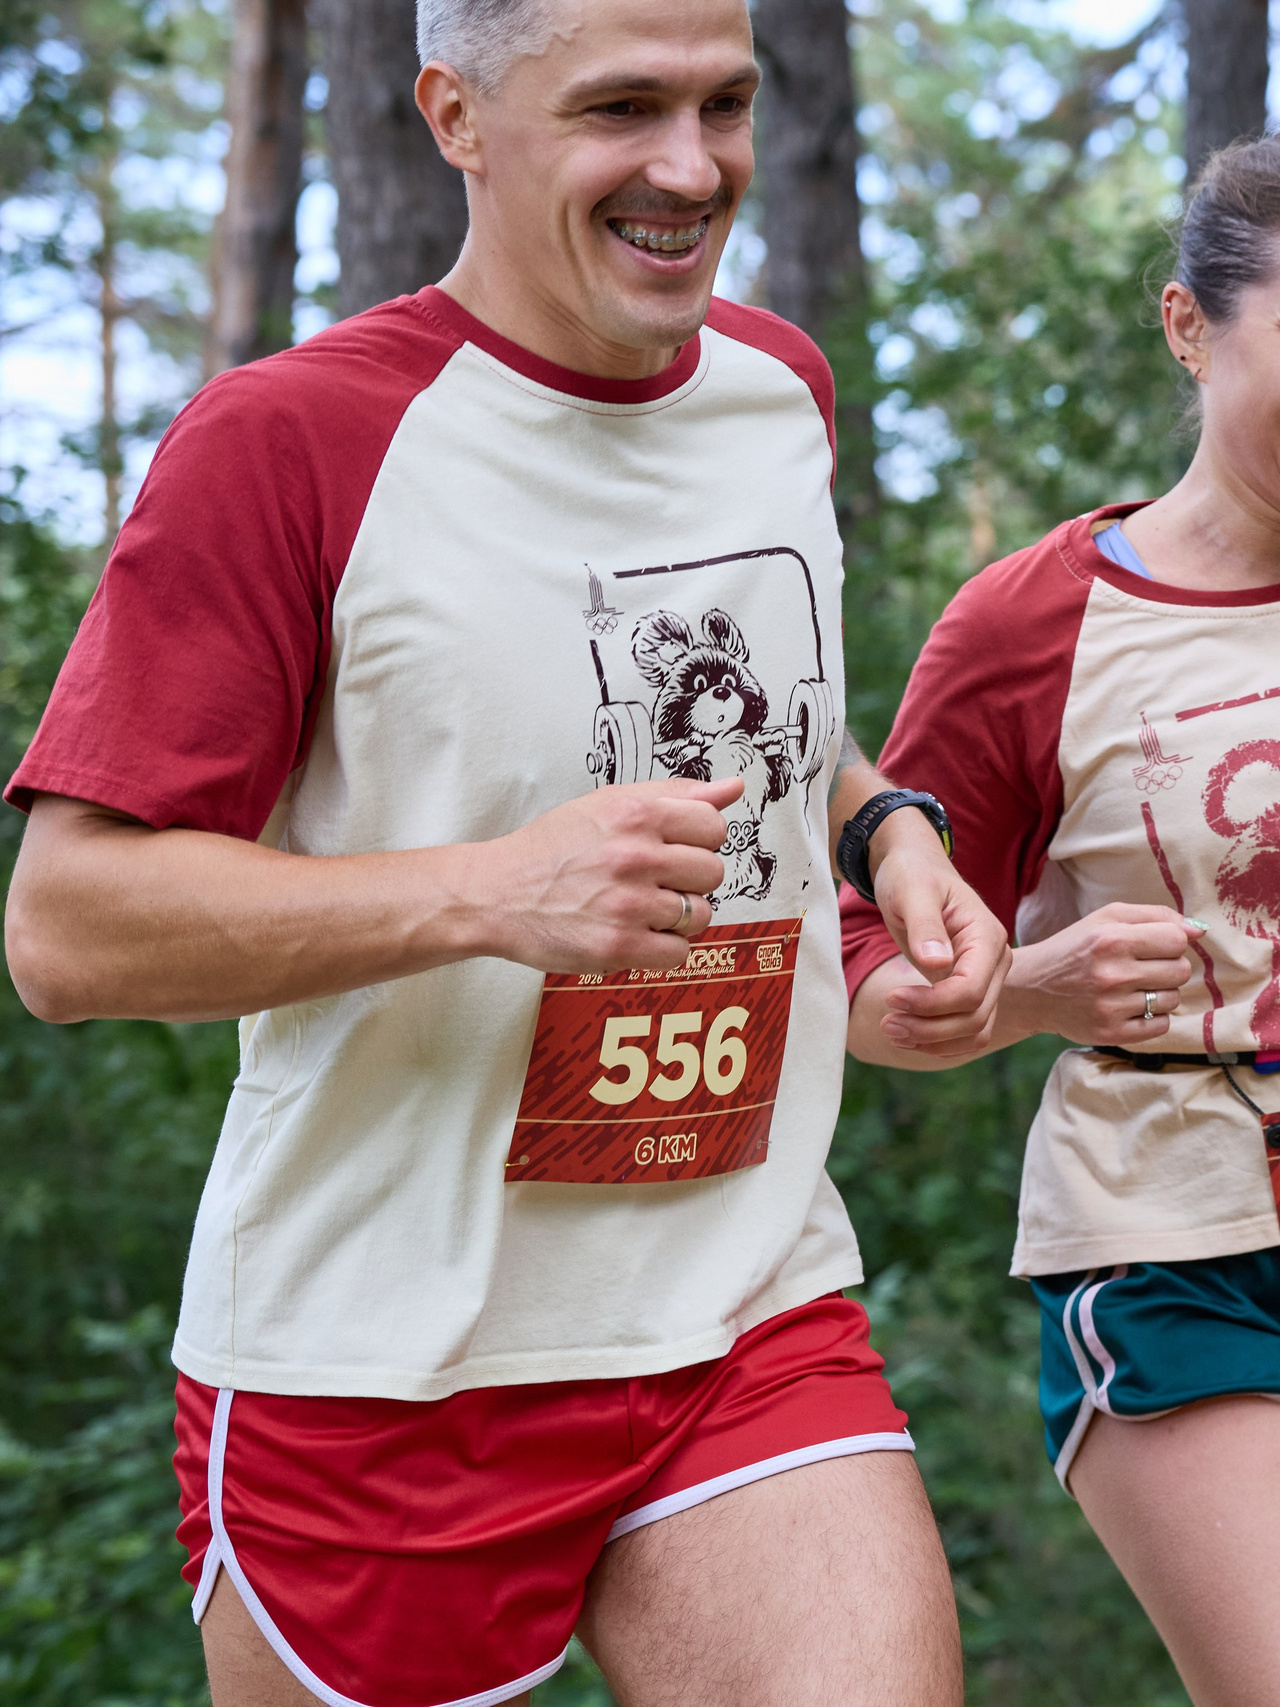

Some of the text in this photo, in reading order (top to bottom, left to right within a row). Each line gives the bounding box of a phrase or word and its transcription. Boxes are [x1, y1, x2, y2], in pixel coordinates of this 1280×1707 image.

[685, 947, 737, 969] КРОСС
[758, 945, 780, 959] СПОРТ
[761, 956, 782, 970] СОЮЗ
[578, 974, 603, 985] 2026
[643, 970, 662, 983] дню
[666, 964, 736, 982] физкультурника
[588, 1005, 750, 1106] 556
[635, 1137, 655, 1165] 6
